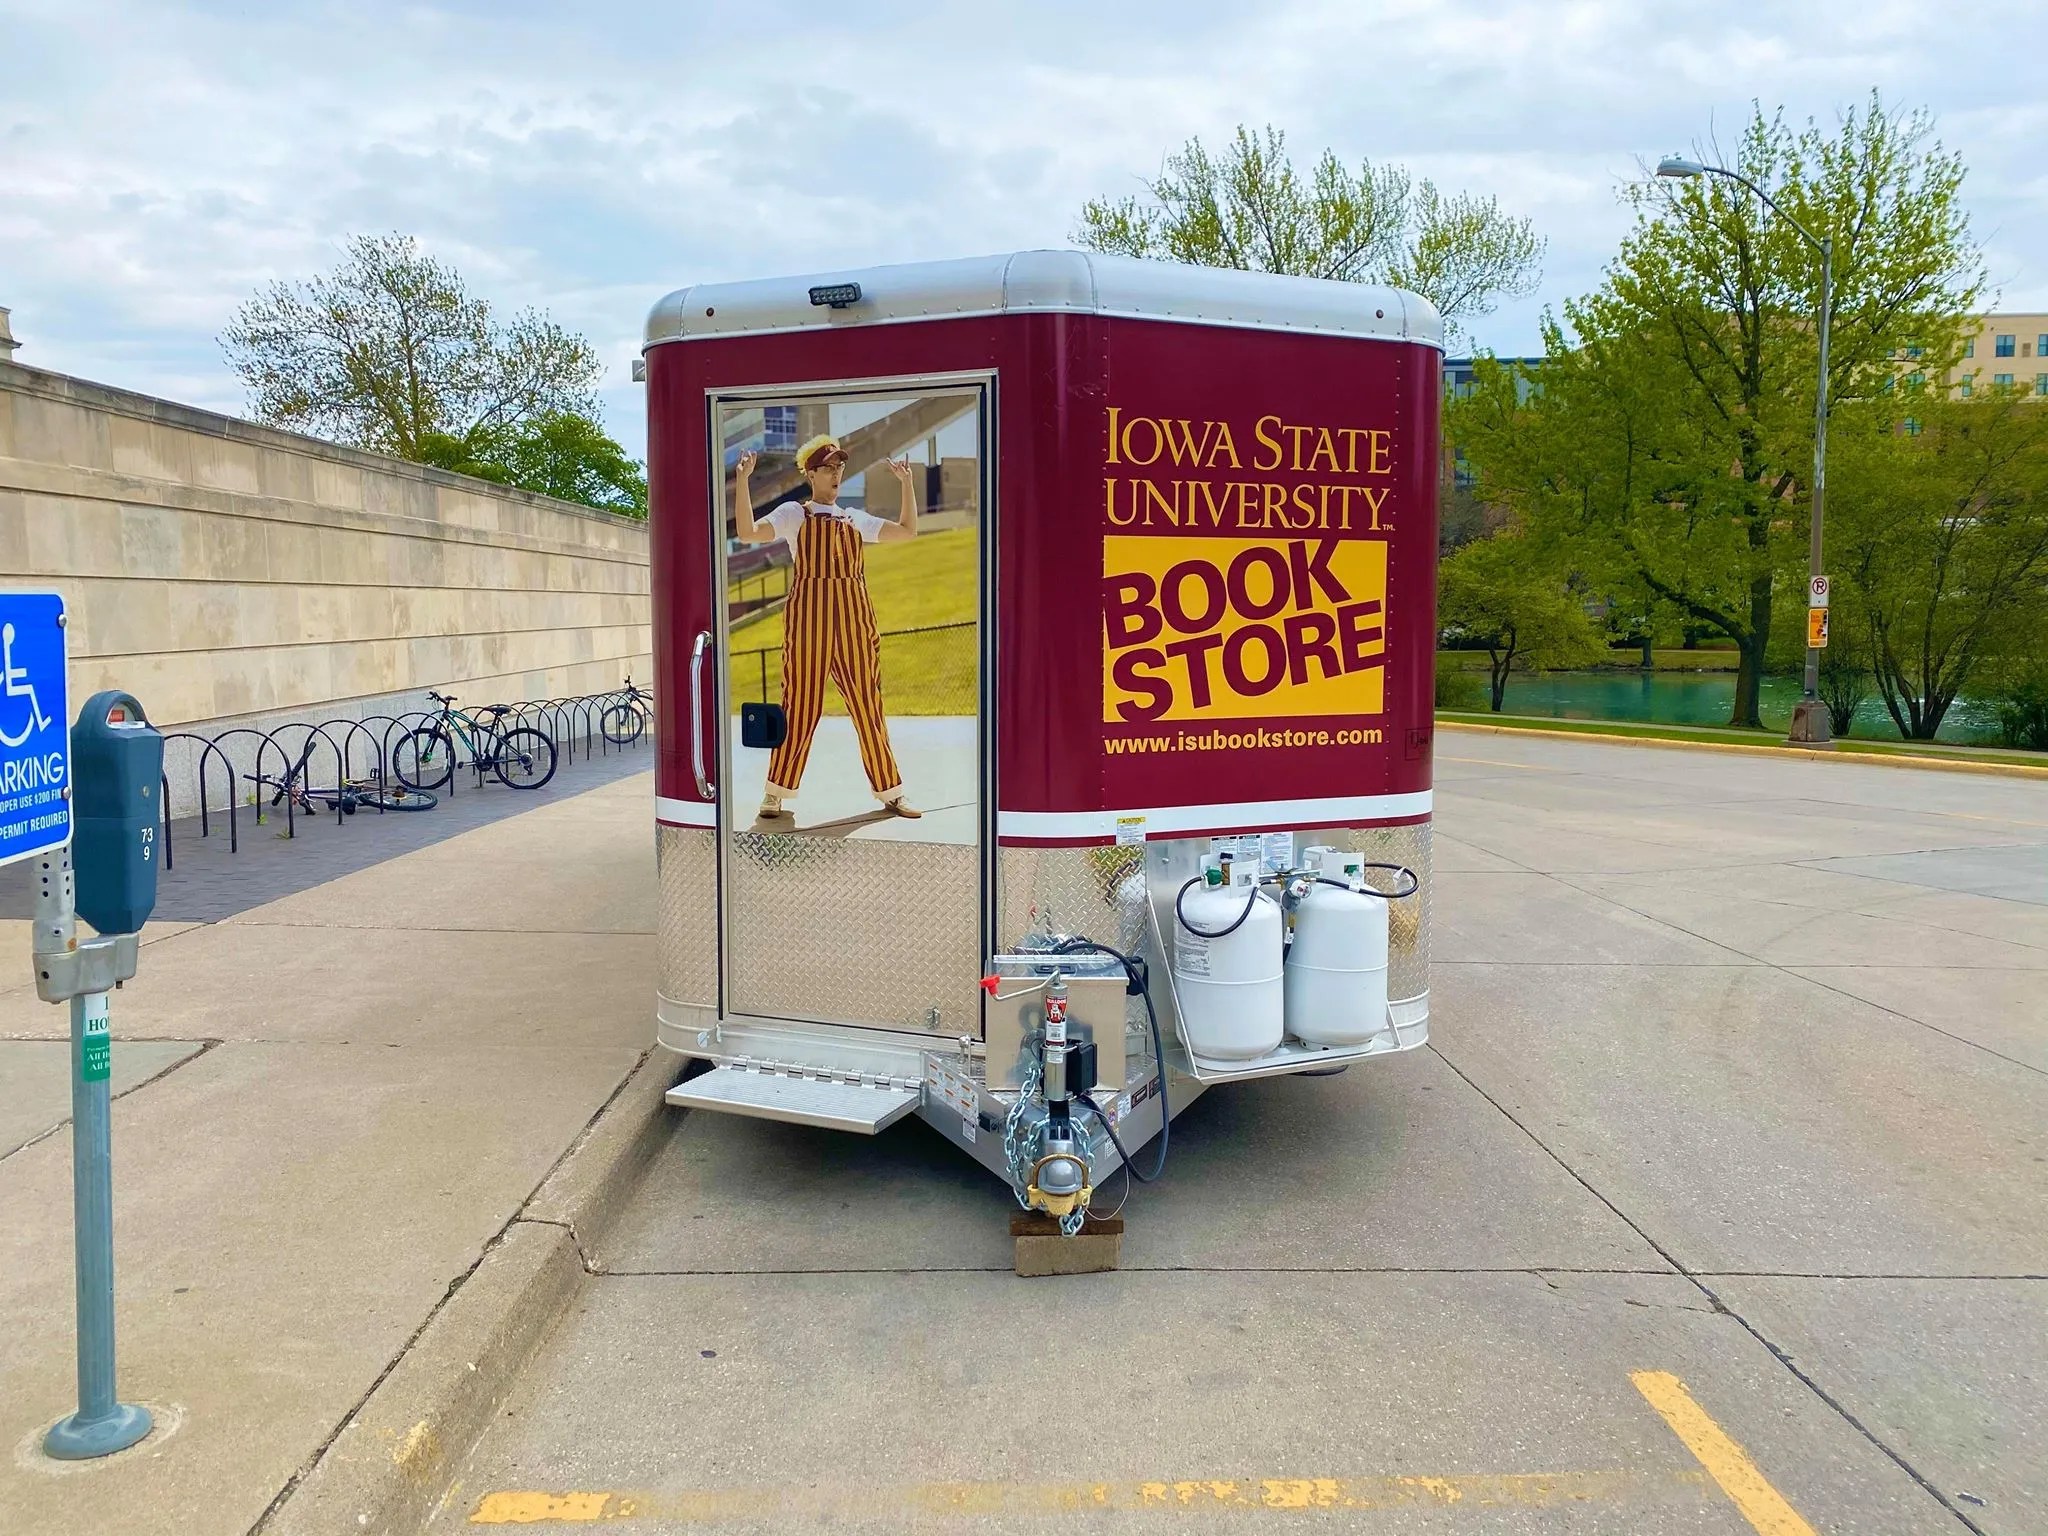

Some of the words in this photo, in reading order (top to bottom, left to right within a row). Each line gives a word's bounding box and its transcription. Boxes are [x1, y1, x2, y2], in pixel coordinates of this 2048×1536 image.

[1105, 406, 1243, 469] IOWA
[1253, 414, 1392, 475] STATE
[1103, 478, 1391, 531] UNIVERSITY
[1102, 539, 1353, 650] BOOK
[1111, 598, 1386, 723] STORE
[1104, 727, 1383, 754] www.isubookstore.com
[19, 794, 33, 809] USE
[34, 790, 50, 805] $200
[30, 810, 68, 832] REQUIRED
[141, 827, 153, 843] 73
[143, 845, 150, 861] 9
